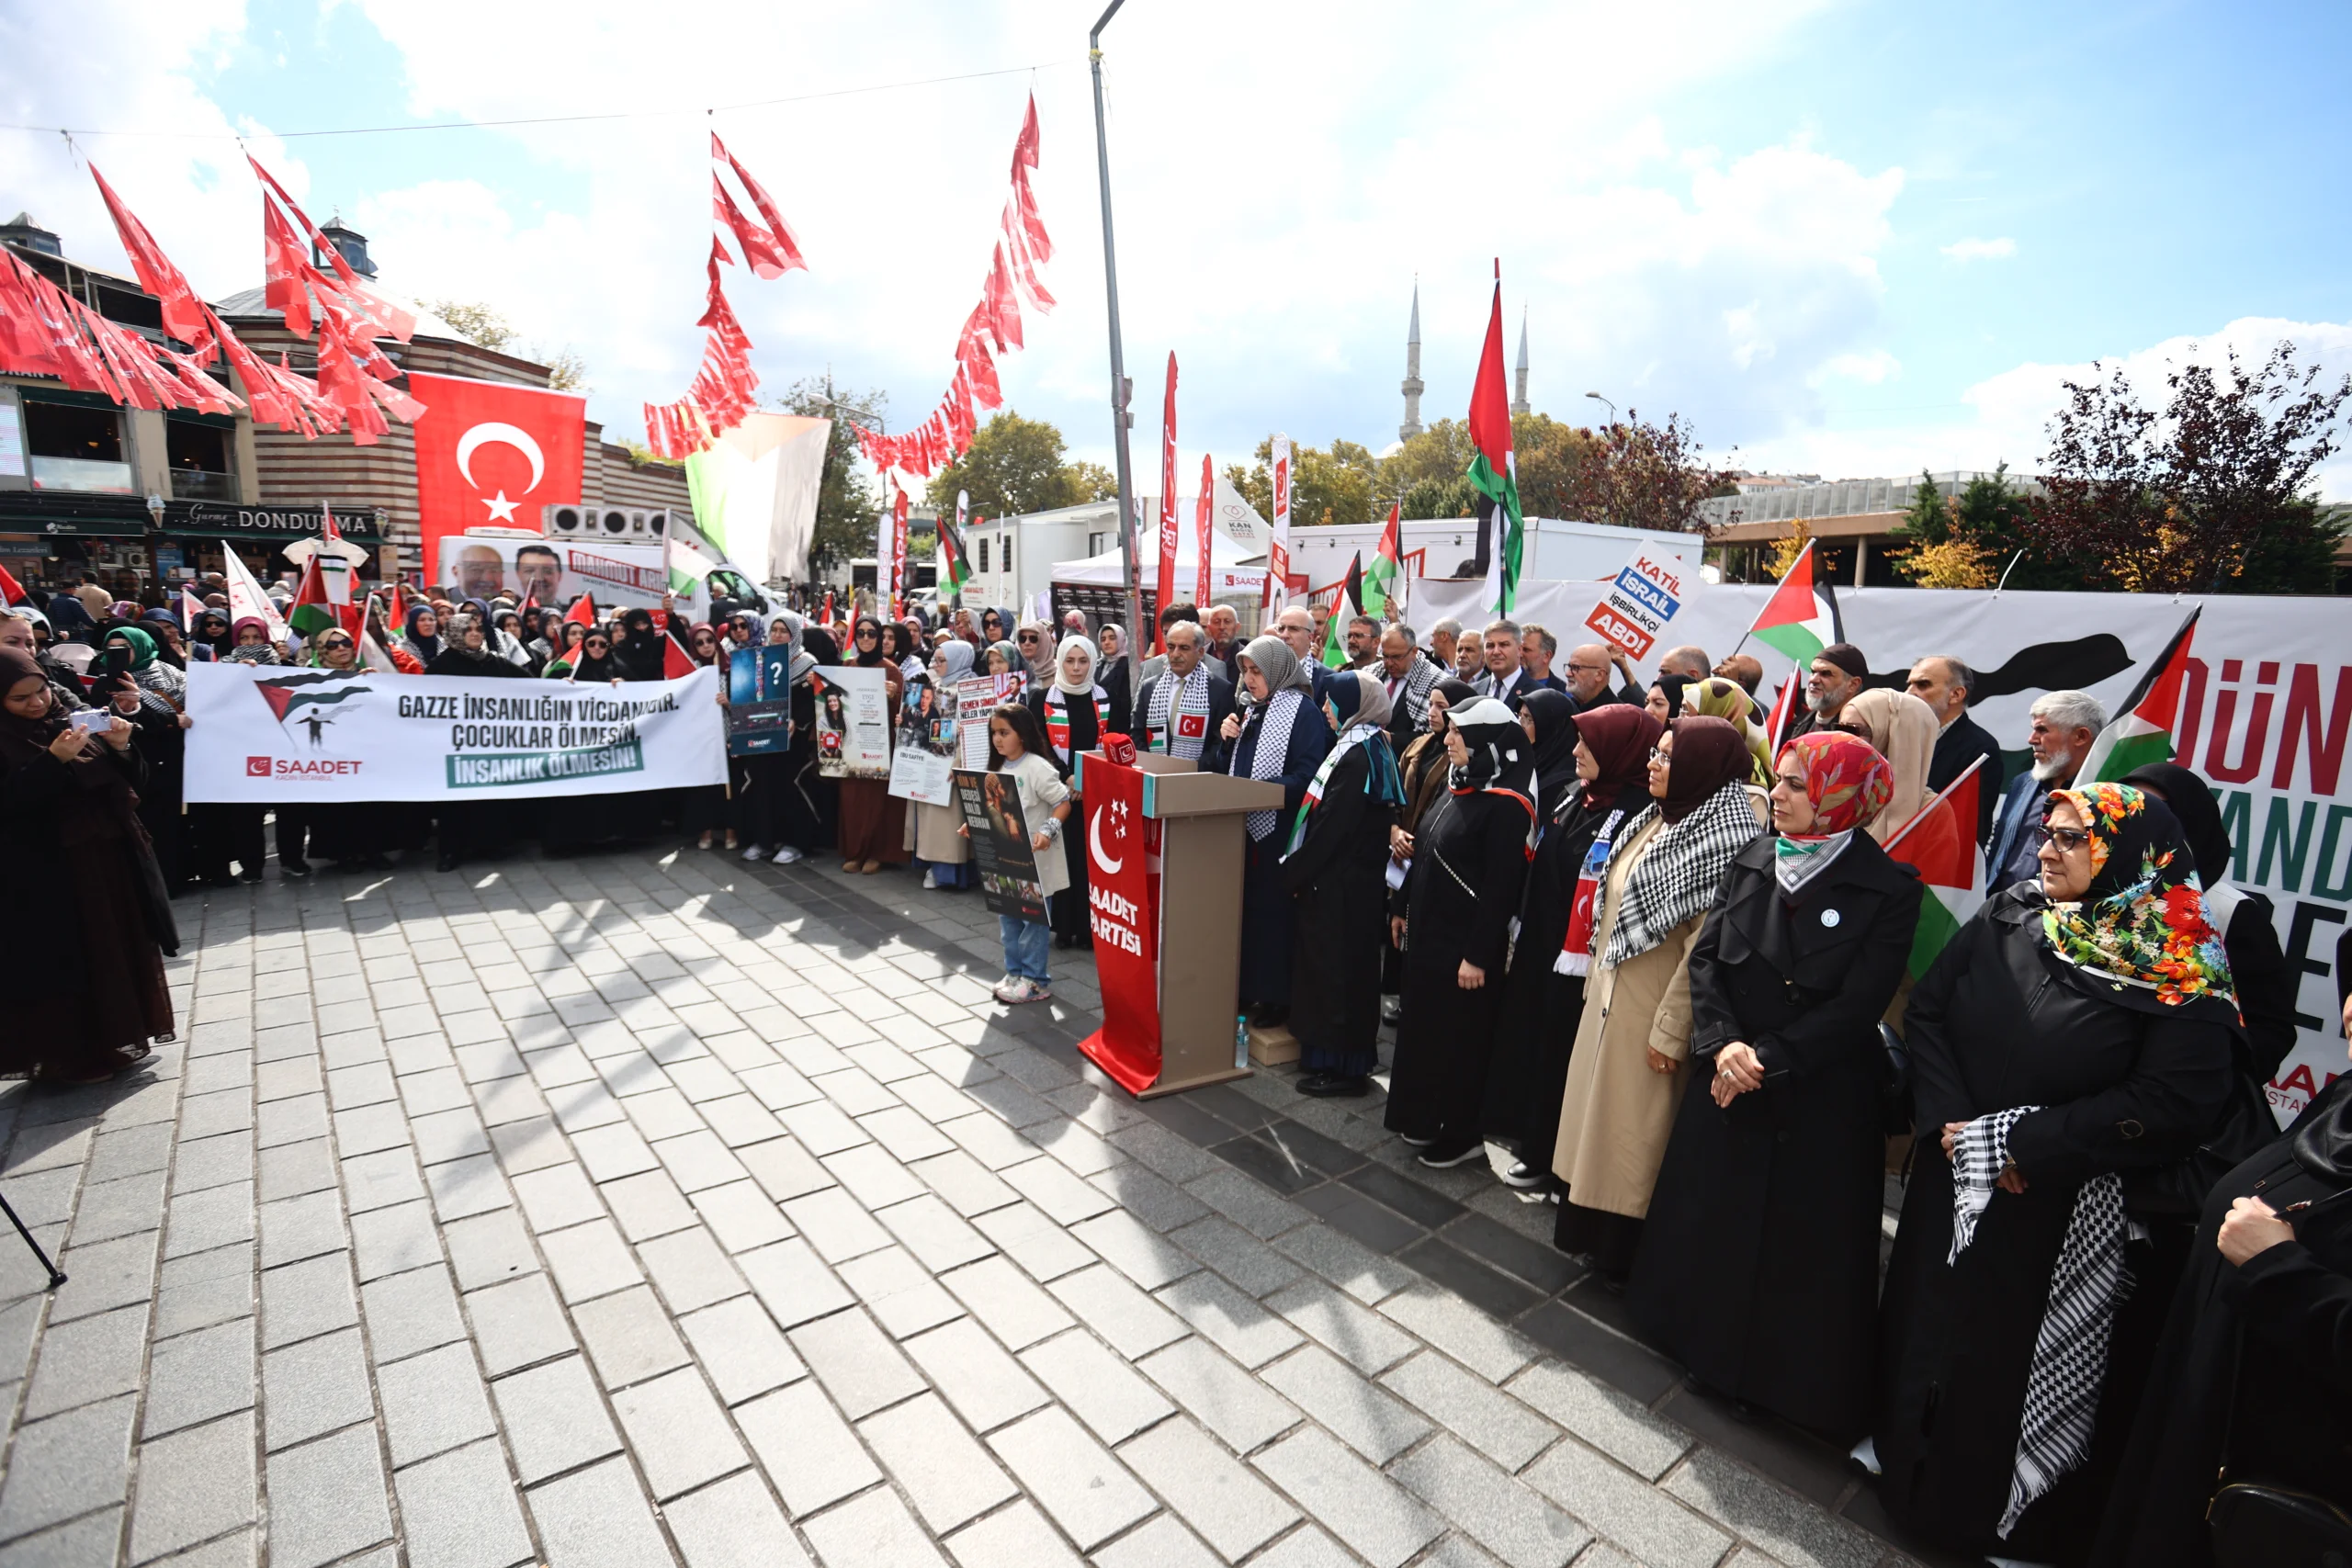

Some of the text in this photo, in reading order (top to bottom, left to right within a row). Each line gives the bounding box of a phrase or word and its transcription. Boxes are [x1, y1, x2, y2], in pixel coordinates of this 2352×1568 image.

[571, 551, 636, 584] MAHMUT
[895, 509, 905, 599] SAADET
[1621, 570, 1669, 617] İSRAİL
[1635, 557, 1680, 597] KATİL
[1609, 592, 1661, 632] İŞBİRLİKÇİ
[1593, 613, 1647, 654] ABD!
[770, 661, 784, 685] ?
[399, 695, 458, 719] GAZZE
[463, 693, 572, 722] İNSANLIĞIN
[959, 699, 979, 711] HEMEN
[960, 710, 978, 720] NELER
[452, 721, 641, 751] ÇOCUKLAR ÖLMESİN.
[276, 760, 364, 775] SAADET
[454, 745, 637, 784] İNSANLIK ÖLMESİN!
[1090, 908, 1142, 957] PARTİSİ
